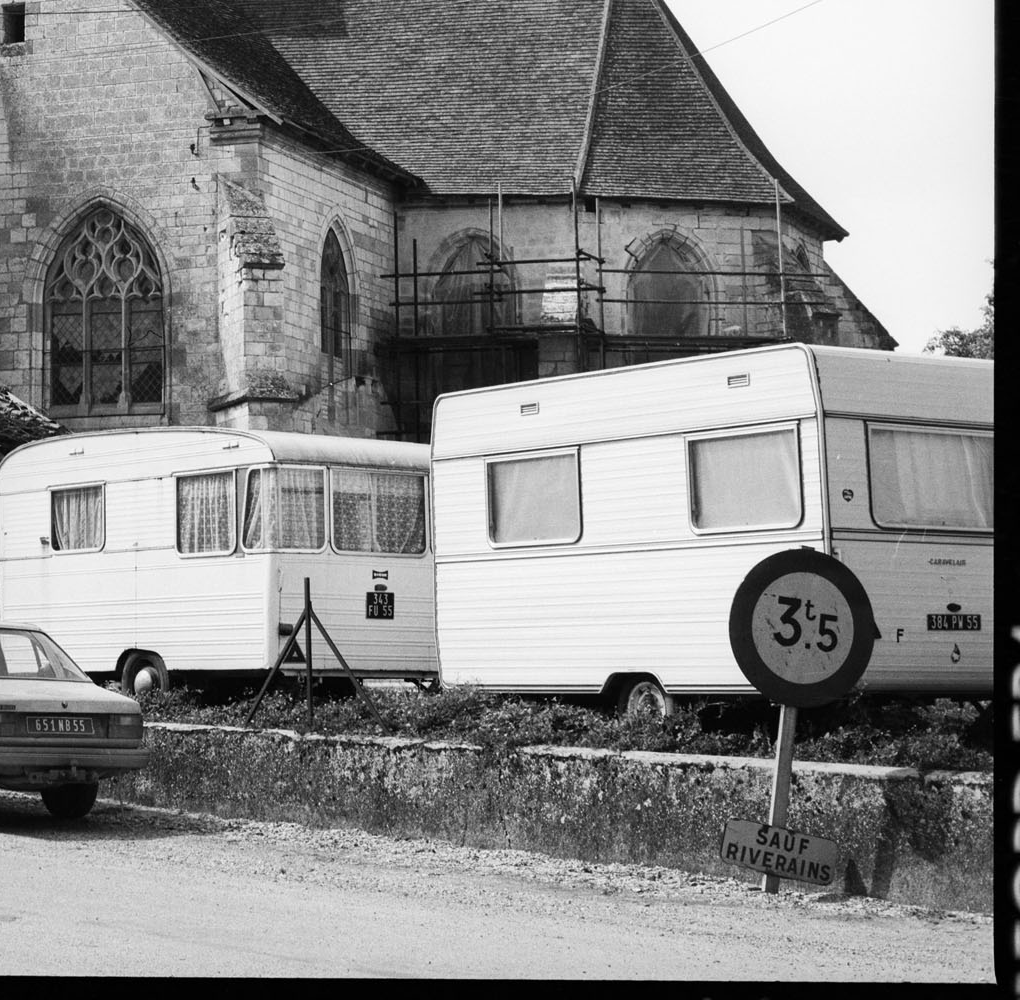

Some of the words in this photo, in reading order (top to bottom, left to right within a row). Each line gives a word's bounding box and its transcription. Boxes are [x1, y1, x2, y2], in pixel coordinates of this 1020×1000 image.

[373, 593, 388, 604] 343
[368, 605, 379, 616] FU
[382, 605, 393, 616] 55
[931, 615, 948, 629] 384
[966, 615, 979, 630] 55
[896, 628, 905, 643] F
[755, 828, 810, 855] SAUF
[725, 841, 831, 882] RIVERAINS
